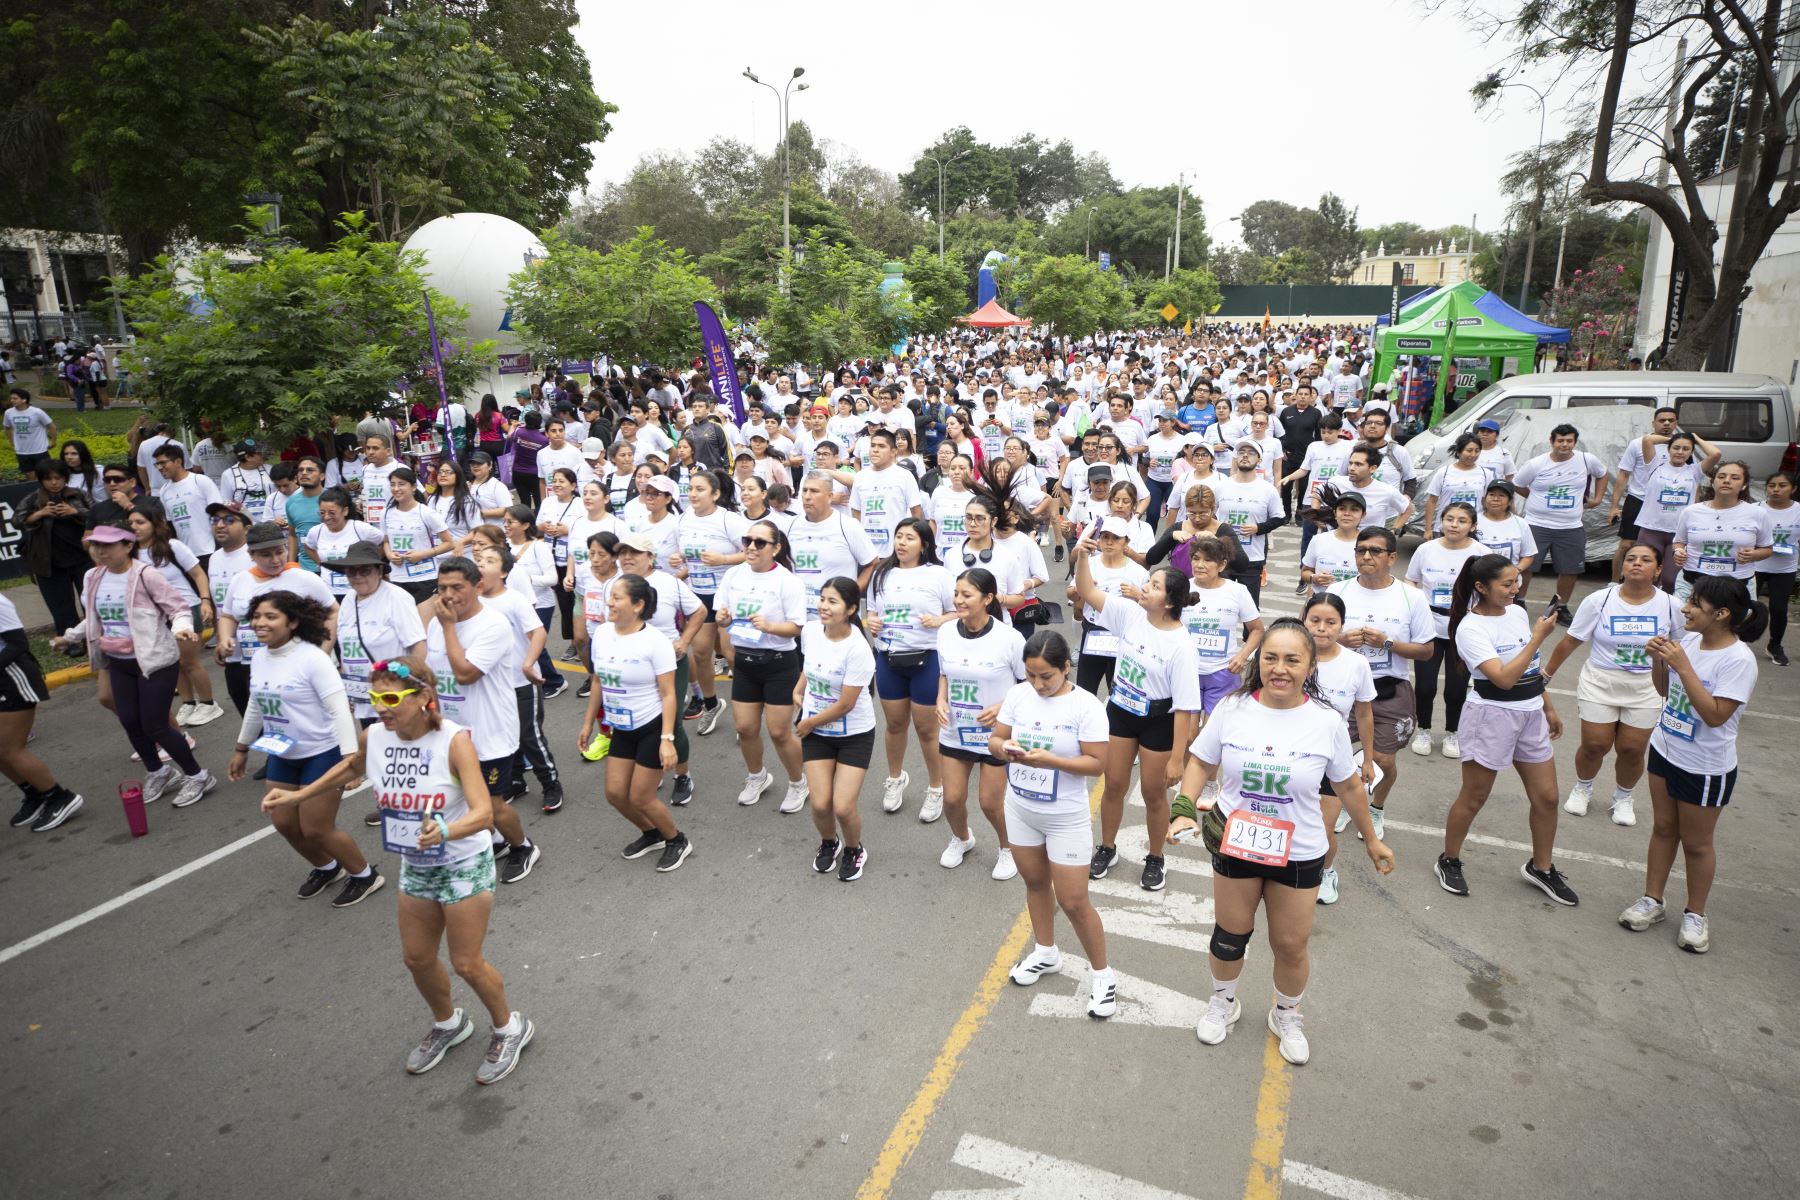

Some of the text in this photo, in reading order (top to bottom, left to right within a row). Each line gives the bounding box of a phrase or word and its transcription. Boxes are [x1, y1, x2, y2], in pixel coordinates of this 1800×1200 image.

[1320, 468, 1336, 477] 5K
[369, 487, 384, 498] 5K
[172, 504, 188, 518] 5K
[866, 498, 885, 512] 5K
[944, 518, 964, 531] 5K
[1228, 514, 1250, 525] 5K
[393, 538, 413, 550] 5K
[1702, 544, 1733, 557] 5K
[796, 554, 818, 568] 5K
[98, 606, 126, 622] 5K
[736, 602, 762, 618] 5K
[884, 608, 911, 624] 5K
[1622, 623, 1644, 631] 2641
[1196, 638, 1218, 647] 1711
[343, 642, 364, 658] 5K
[1615, 648, 1650, 666] 5K
[600, 672, 622, 688] 5K
[1119, 659, 1148, 690] 5K
[436, 678, 460, 695] 5K
[806, 677, 833, 697] 5K
[950, 684, 979, 703] 5K
[258, 698, 283, 716] 5K
[1663, 716, 1682, 730] 2639
[1033, 734, 1055, 742] CORRE
[385, 747, 420, 760] ama
[386, 760, 429, 776] dona
[1264, 764, 1291, 772] CORRE
[382, 776, 416, 789] vive
[1013, 768, 1047, 786] 1564
[1242, 770, 1290, 796] 5K
[1258, 817, 1272, 826] LIMA
[1232, 822, 1284, 852] 2931
